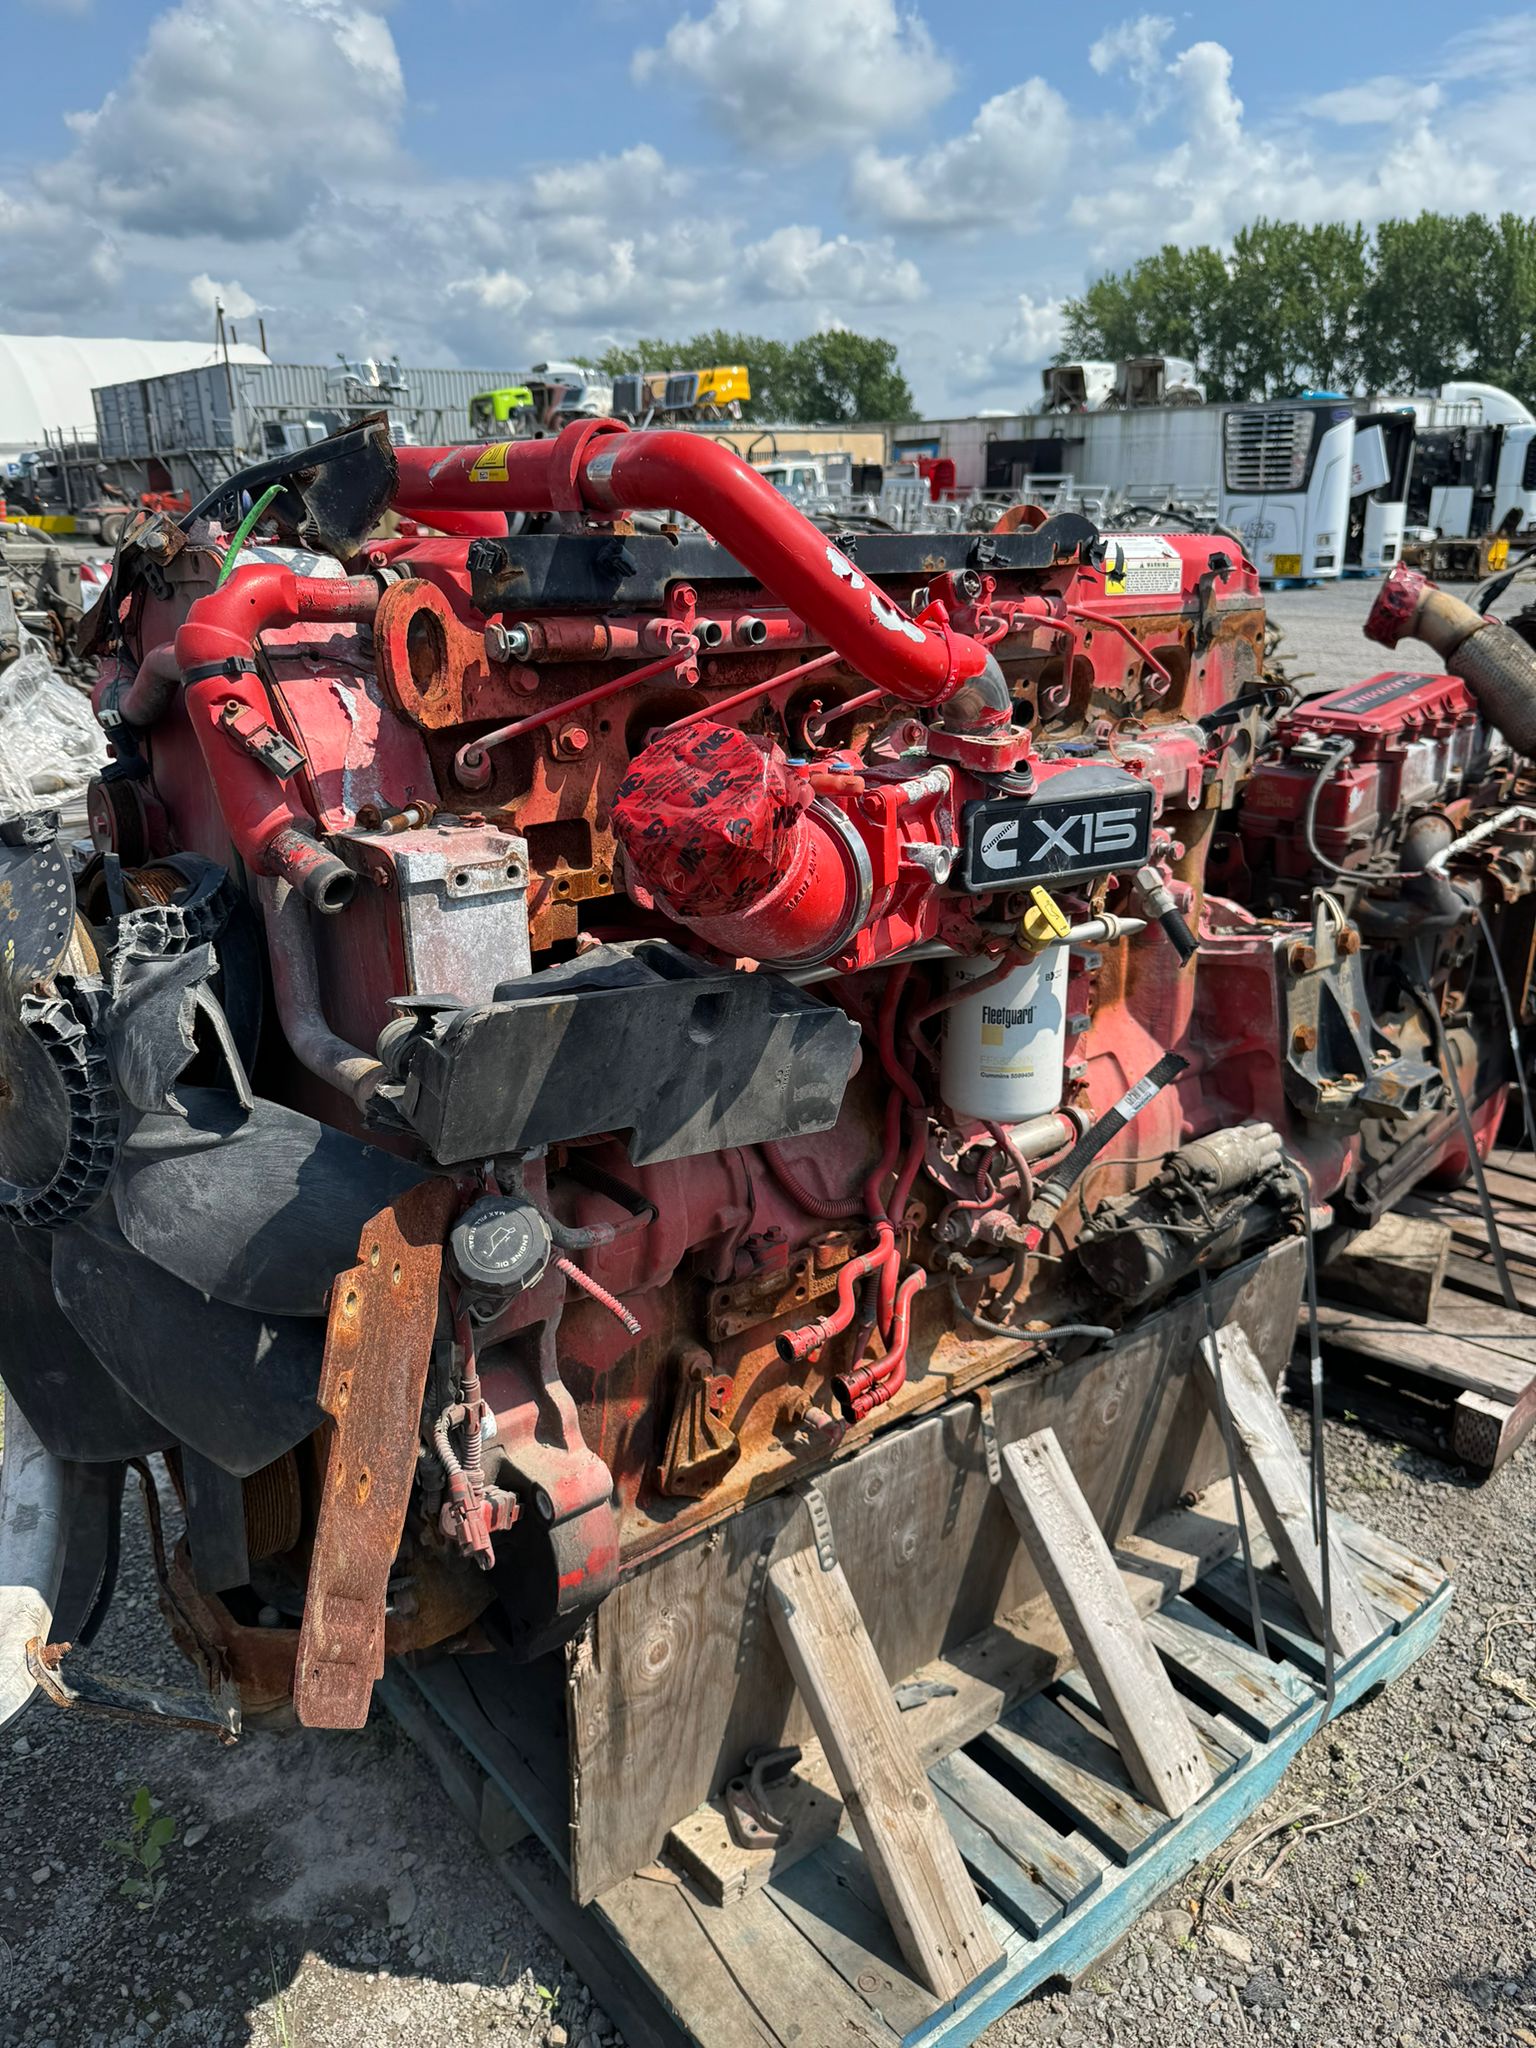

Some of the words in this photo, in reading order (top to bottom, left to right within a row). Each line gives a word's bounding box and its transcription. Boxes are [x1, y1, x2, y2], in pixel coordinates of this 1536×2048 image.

[691, 727, 736, 759] 3M
[690, 771, 734, 808] 3M
[981, 820, 1017, 854] Cummins
[1029, 807, 1137, 862] X15
[982, 1006, 1034, 1028] Fleetguard
[475, 1215, 488, 1225] FILL
[510, 1234, 529, 1263] ENGINE
